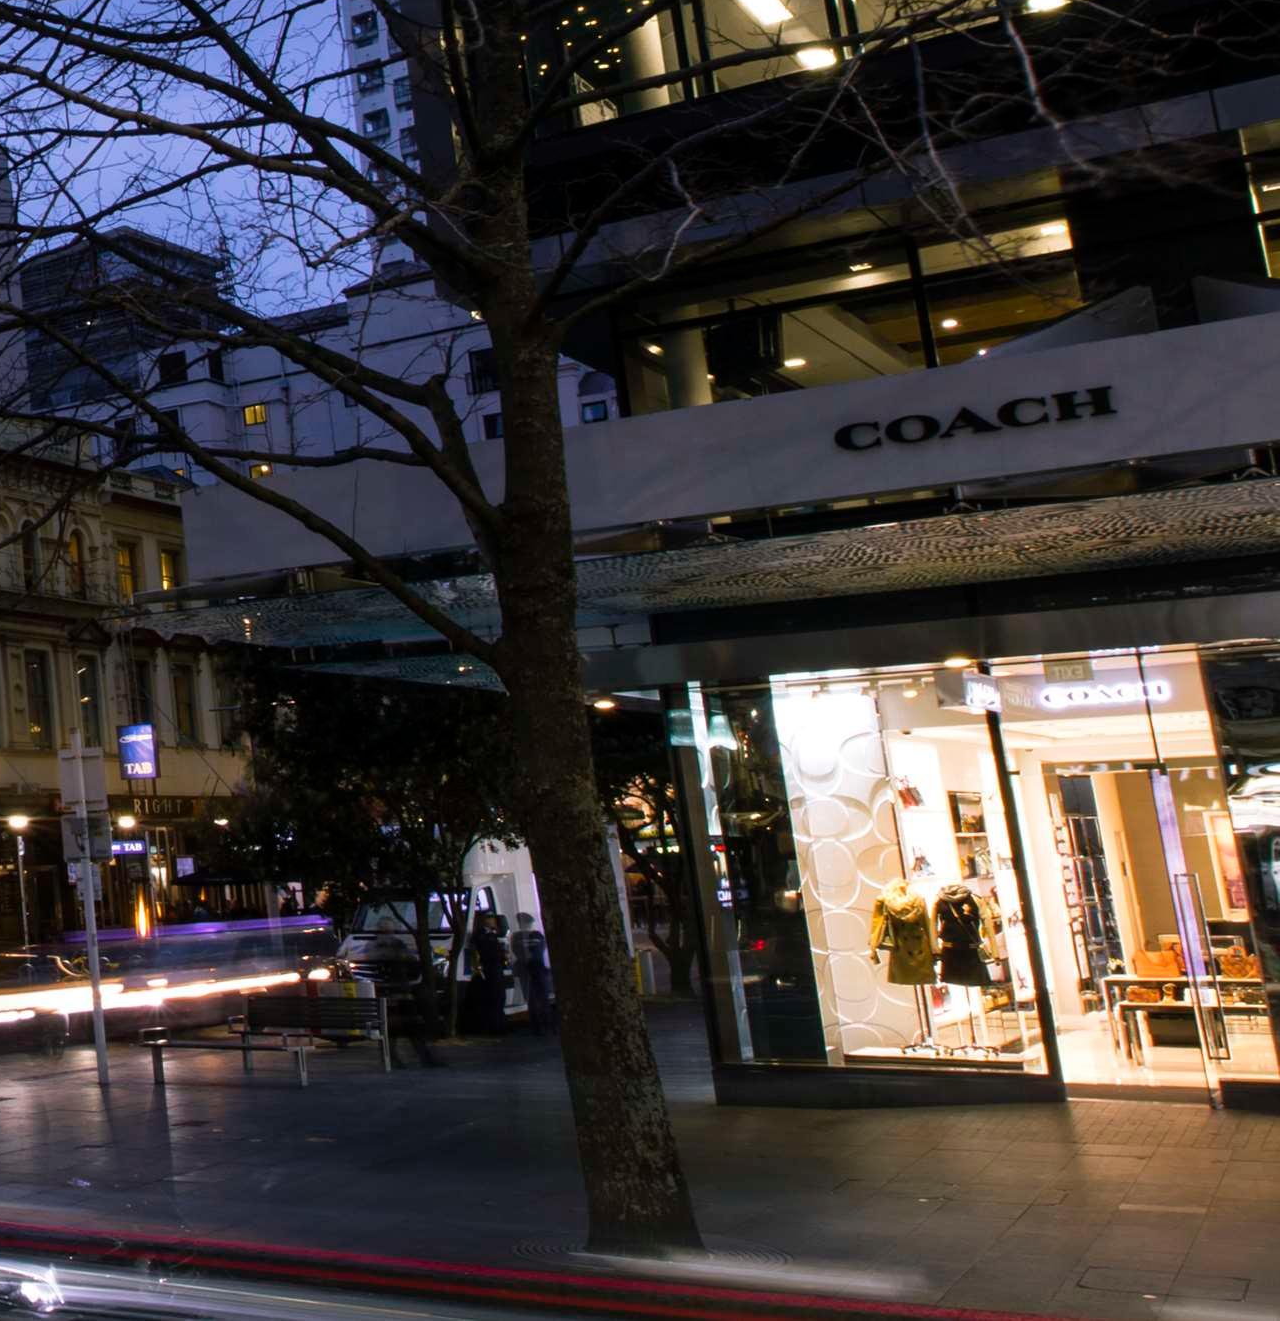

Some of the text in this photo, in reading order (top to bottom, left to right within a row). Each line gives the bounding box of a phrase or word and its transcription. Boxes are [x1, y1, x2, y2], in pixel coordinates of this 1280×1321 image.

[834, 385, 1118, 450] COACH
[124, 761, 153, 775] TAB
[132, 798, 183, 815] RIGHT
[122, 843, 143, 852] TAB
